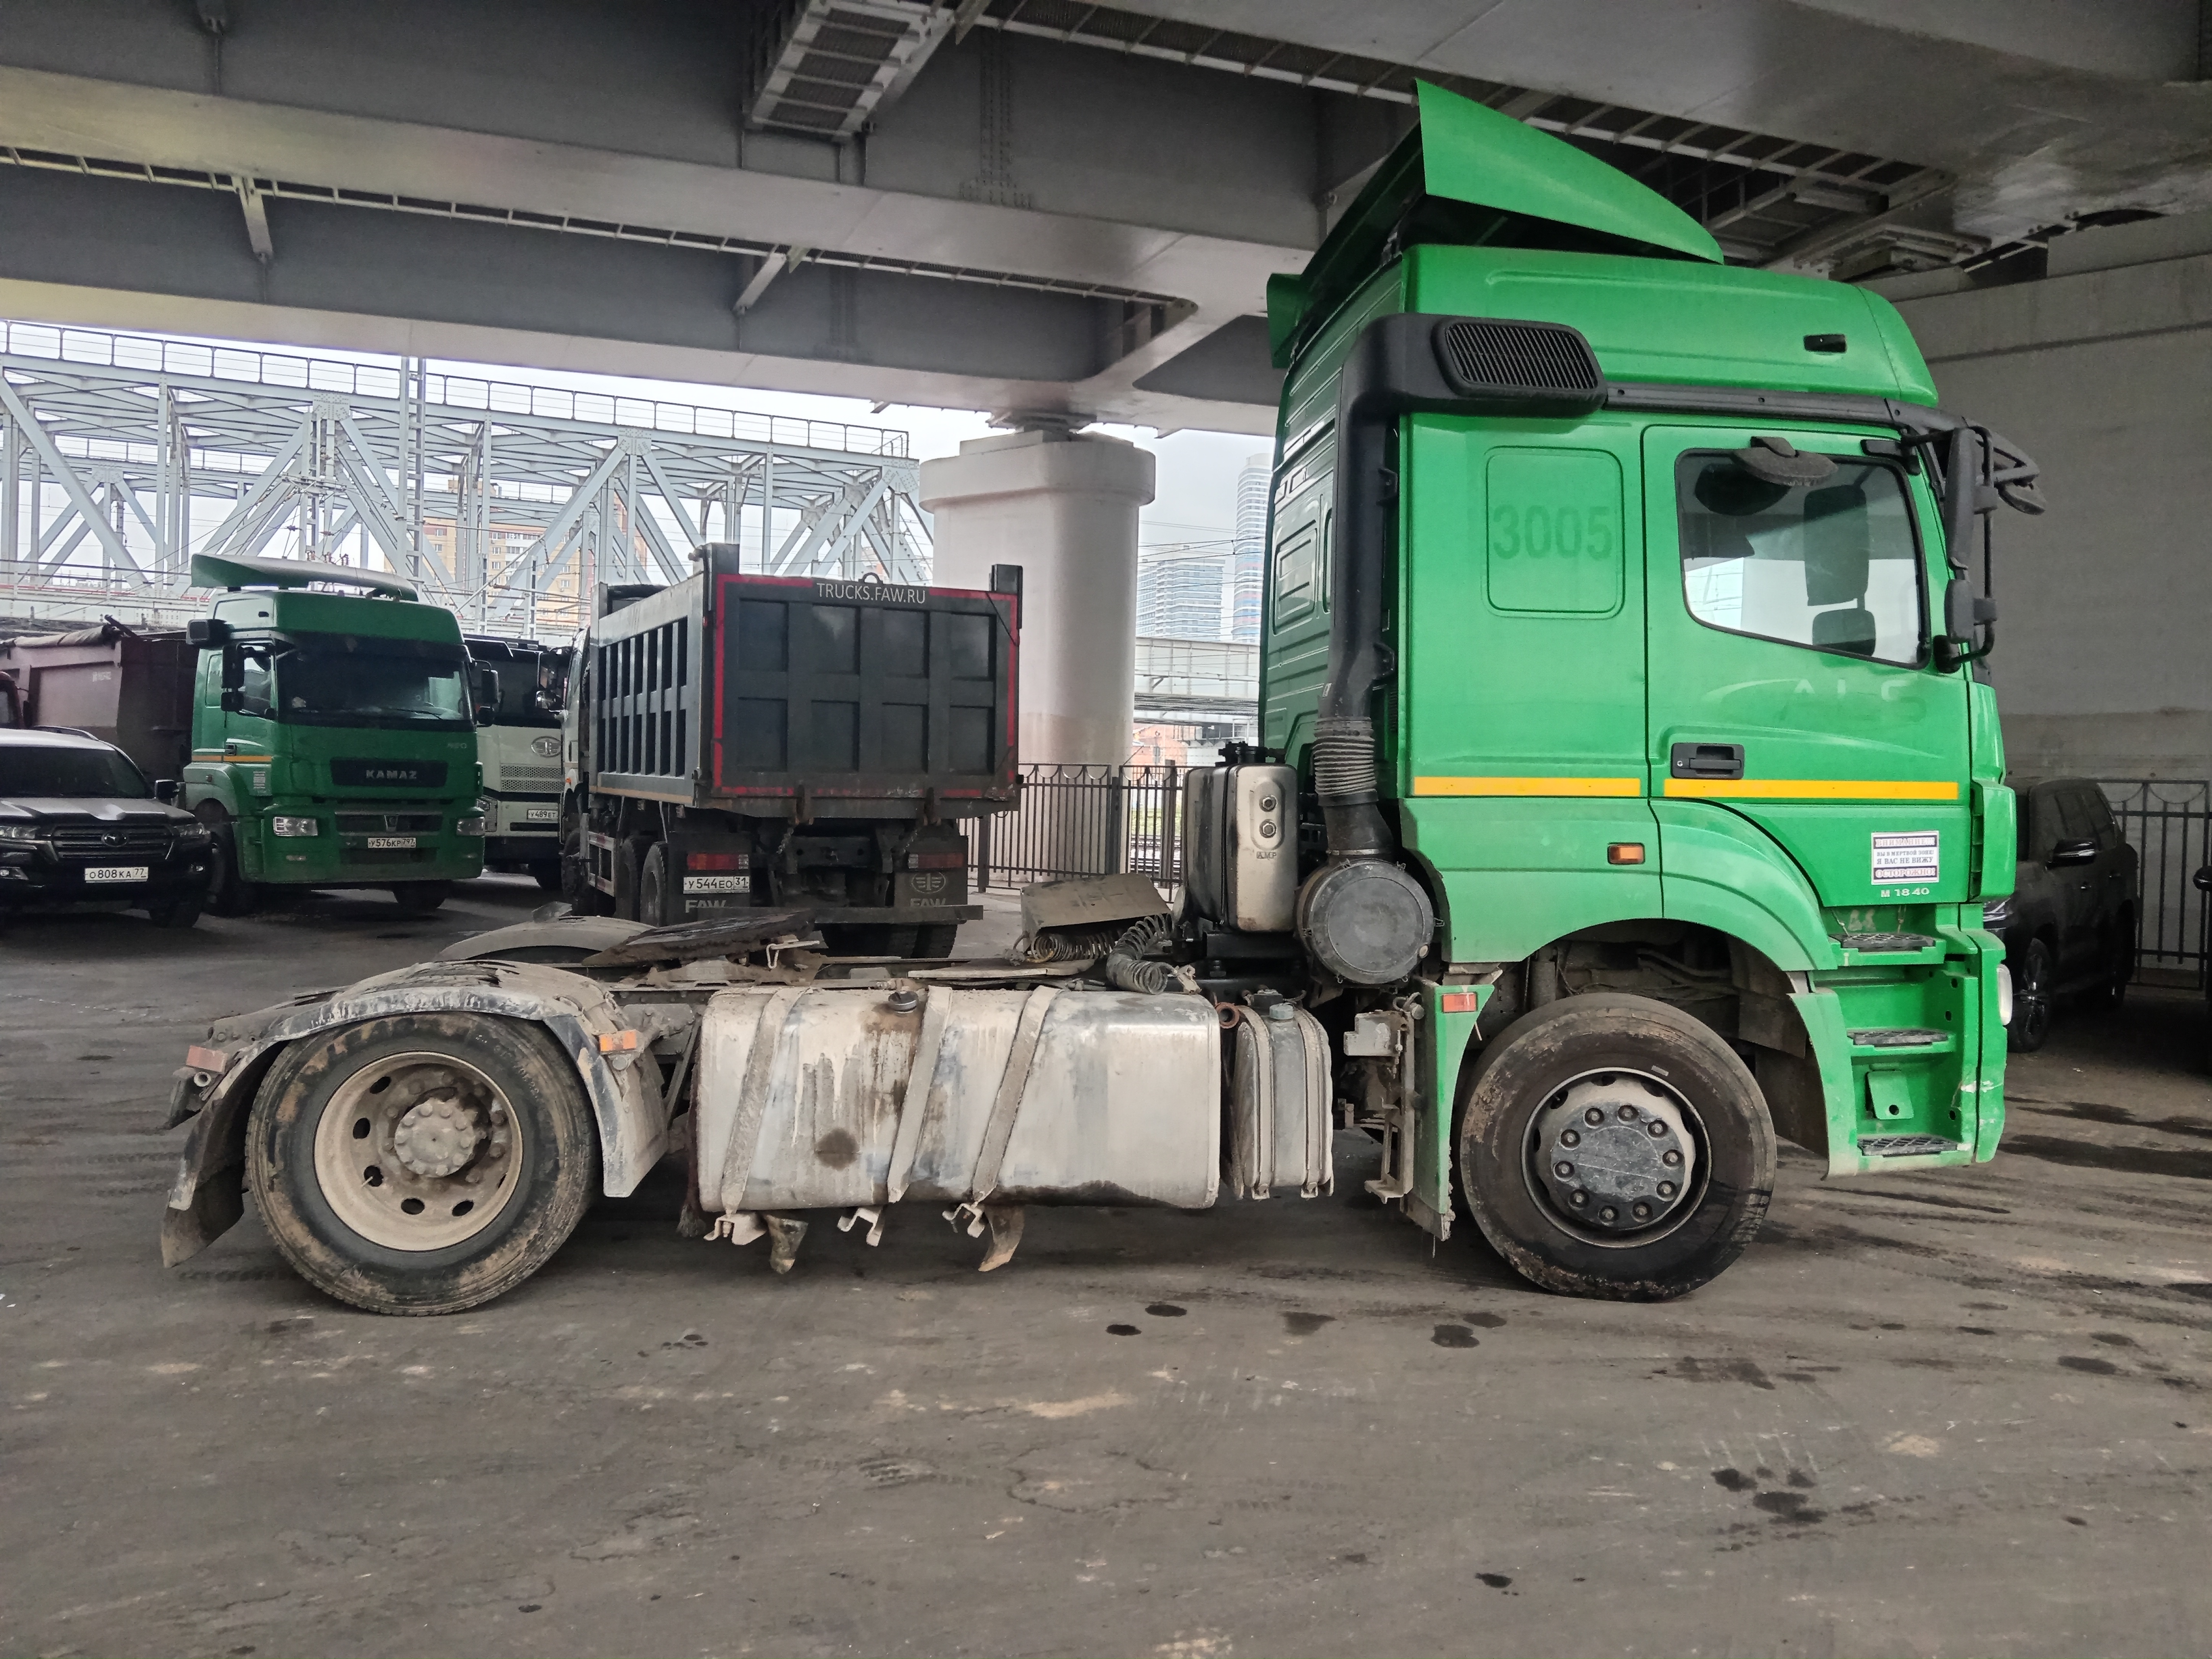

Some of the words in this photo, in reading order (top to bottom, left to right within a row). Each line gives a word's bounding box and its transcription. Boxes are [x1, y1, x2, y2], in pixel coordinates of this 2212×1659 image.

[1492, 504, 1612, 560] 3005
[817, 582, 926, 604] TRUCKS.FAW.RU
[366, 769, 417, 779] KAMAZ
[1876, 868, 1936, 878] ОСТОРОЖНО!
[735, 877, 746, 886] 31
[1881, 889, 1890, 898] M
[1894, 887, 1930, 897] 1840
[685, 899, 727, 913] FAW
[910, 898, 946, 907] FAW
